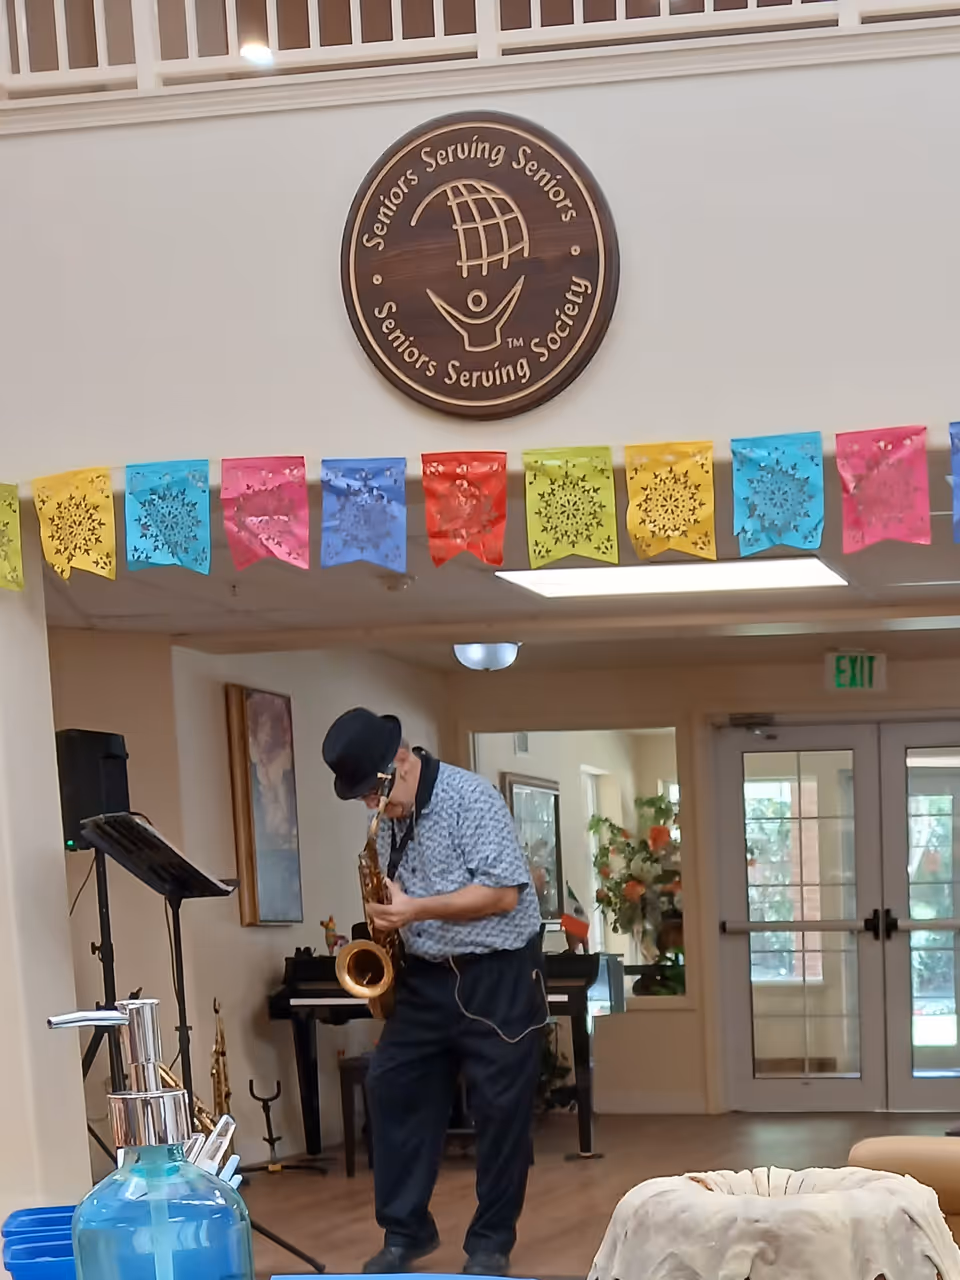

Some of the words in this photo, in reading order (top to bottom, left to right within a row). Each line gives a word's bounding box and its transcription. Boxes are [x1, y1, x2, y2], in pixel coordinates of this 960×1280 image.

[362, 169, 418, 250] Seniors
[421, 135, 506, 172] Serving
[512, 145, 577, 222] Seniors
[374, 301, 438, 377] Seniors
[444, 357, 531, 388] Serving
[530, 276, 592, 362] Society
[506, 337, 525, 349] TM
[835, 656, 876, 689] EXIT
